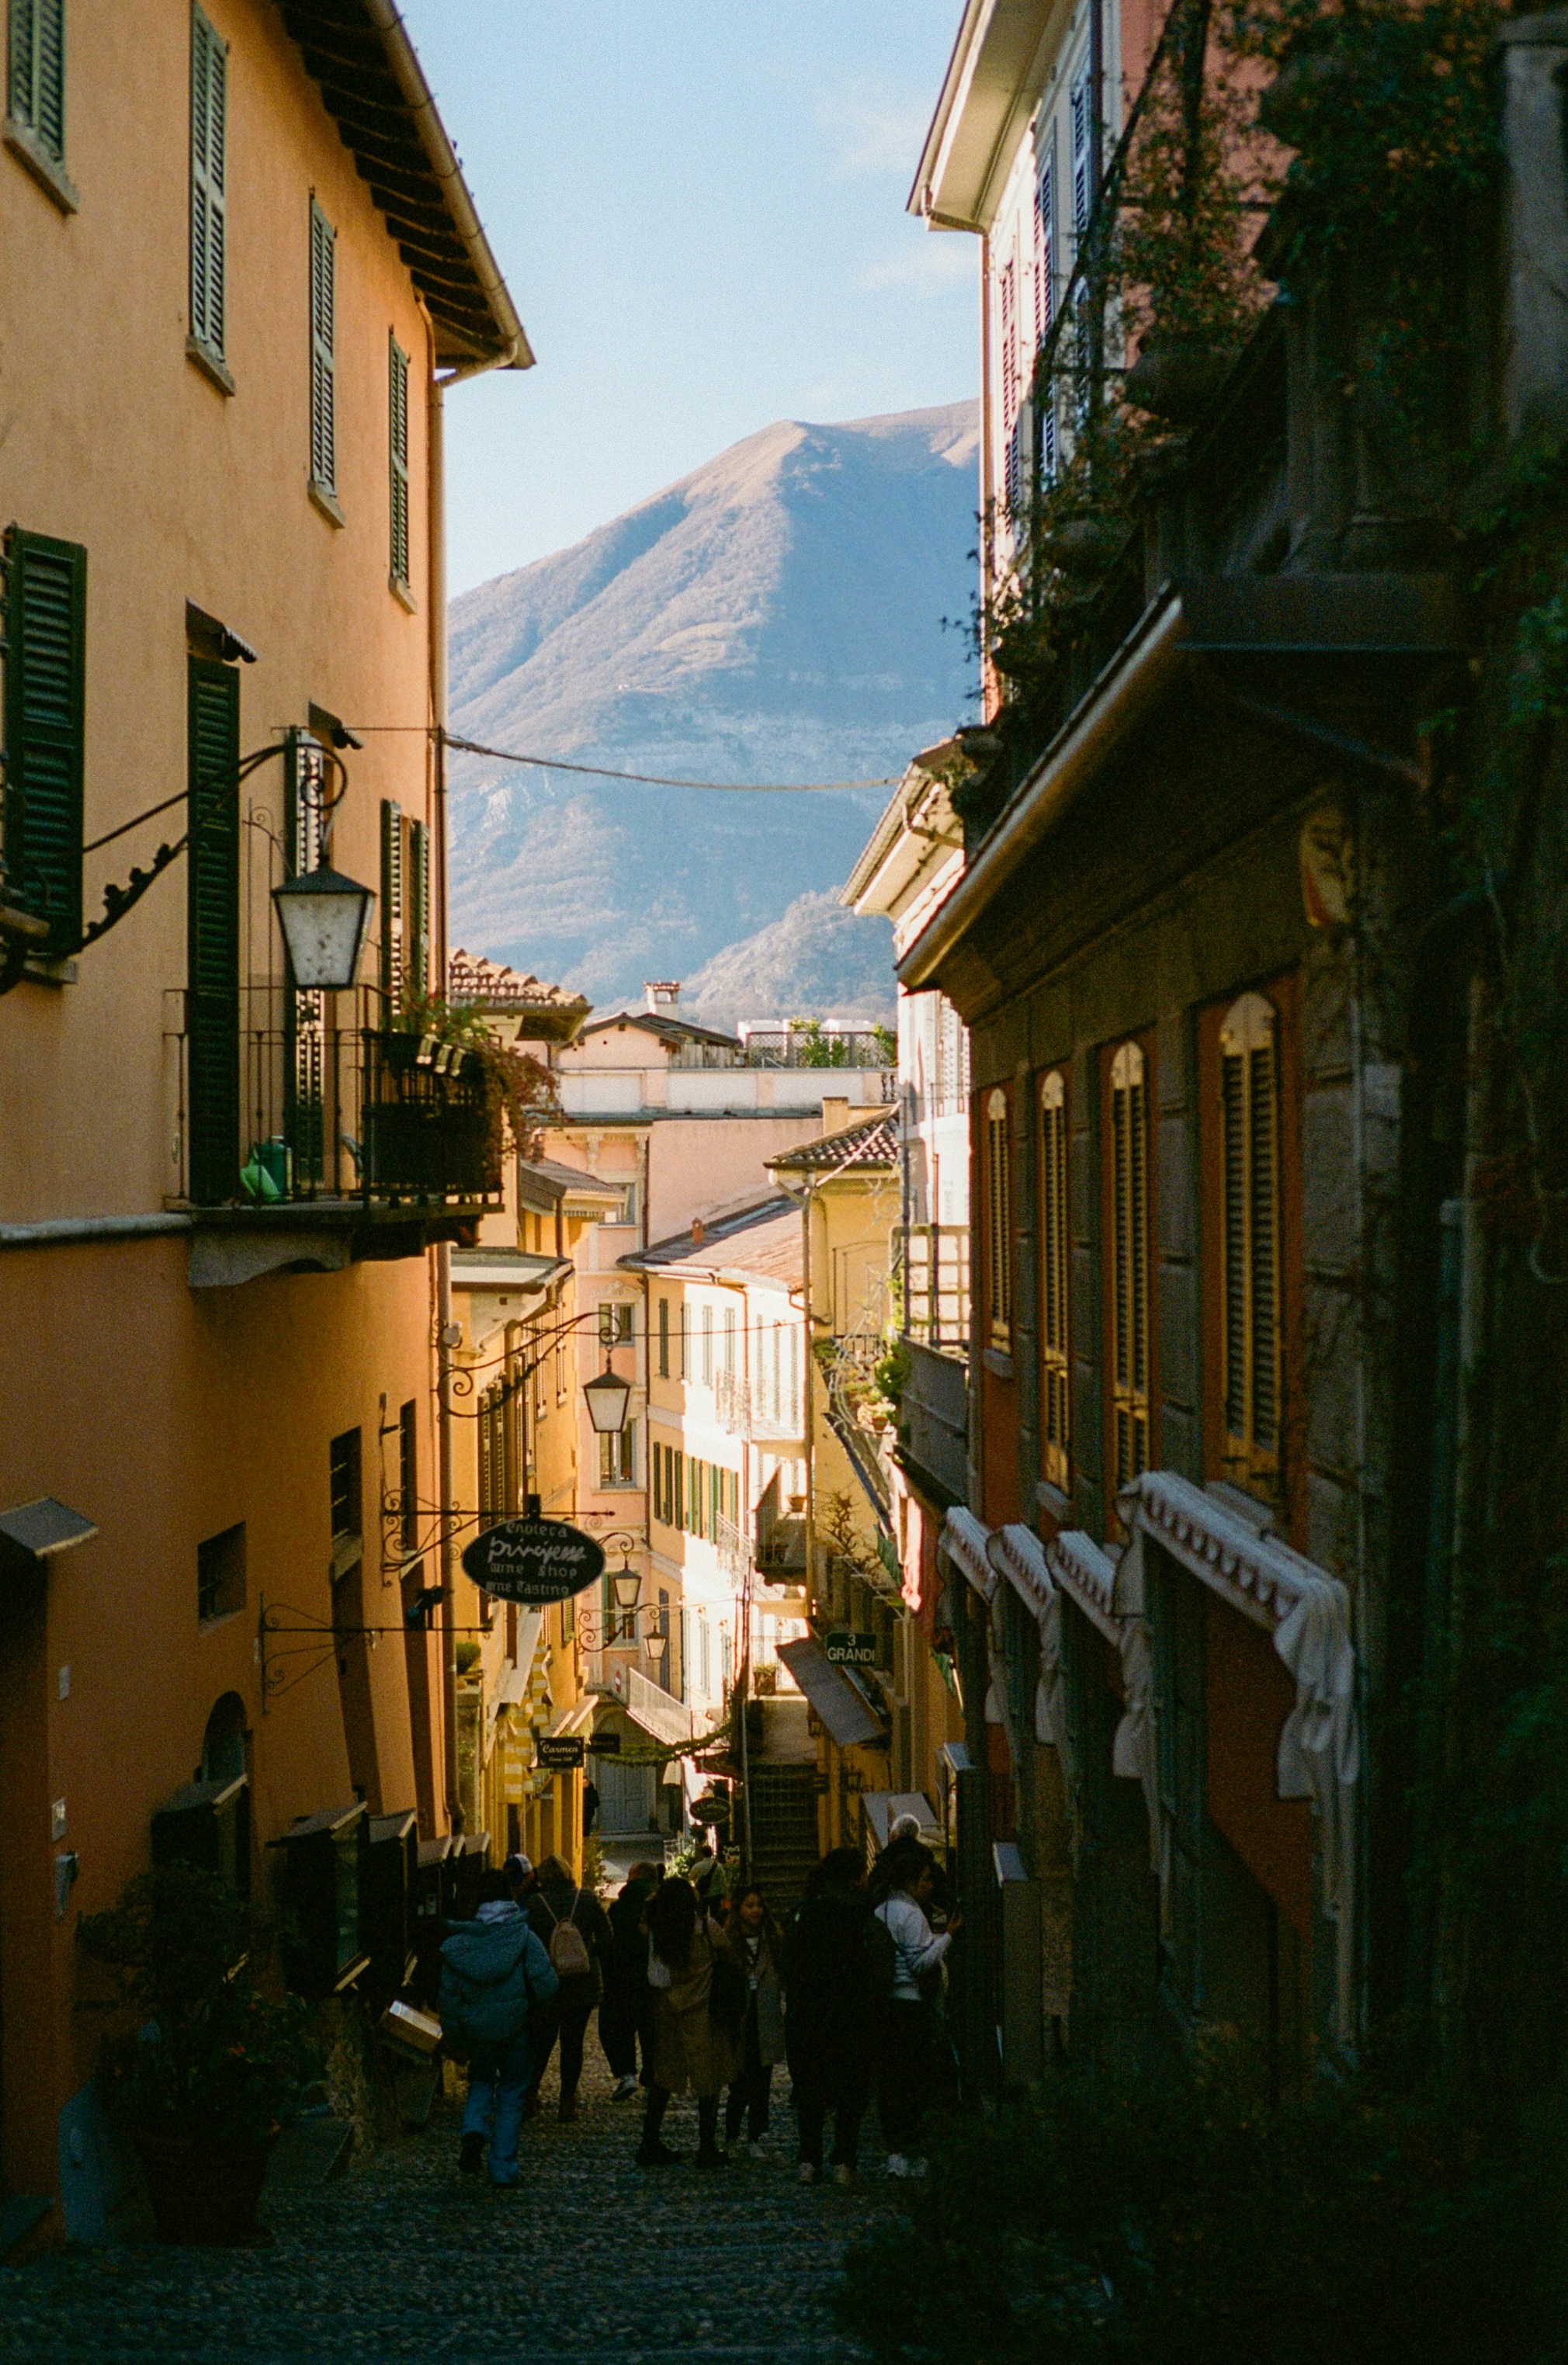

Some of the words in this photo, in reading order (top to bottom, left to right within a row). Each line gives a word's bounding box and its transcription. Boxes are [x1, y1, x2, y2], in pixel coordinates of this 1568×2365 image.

[848, 1634, 856, 1646] 3
[827, 1647, 875, 1662] GRANDI
[542, 1744, 579, 1753] Carmen
